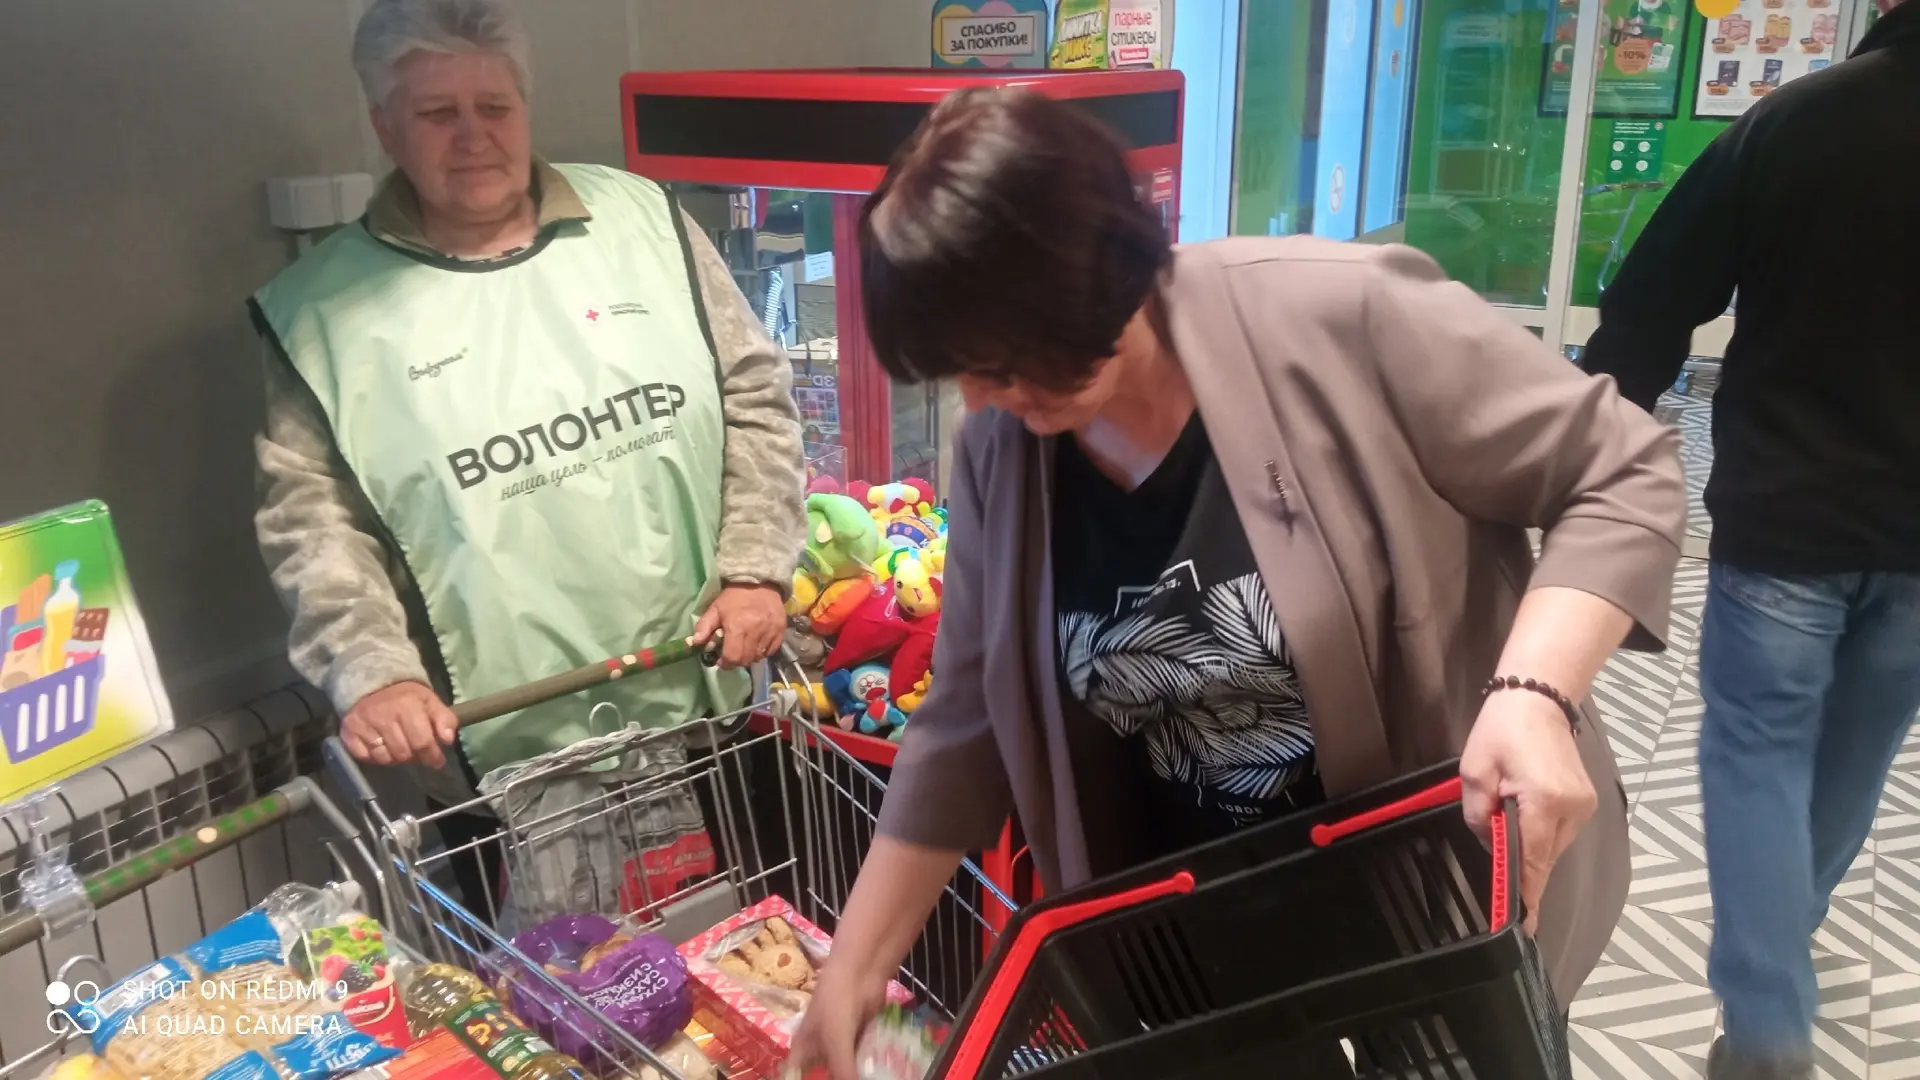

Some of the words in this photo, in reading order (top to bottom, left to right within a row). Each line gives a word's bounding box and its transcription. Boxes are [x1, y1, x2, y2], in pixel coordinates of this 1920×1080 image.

[1114, 12, 1152, 30] парные
[960, 22, 1016, 38] СПАСИБО
[950, 40, 967, 51] ЗА
[967, 36, 1027, 51] ПОКУПКИ!
[1110, 31, 1157, 48] стикеры
[446, 383, 686, 490] ВОЛОНТЕР
[500, 473, 547, 501] наша
[551, 461, 588, 488] цель
[640, 962, 652, 972] С
[616, 976, 669, 1008] СУХАРИ
